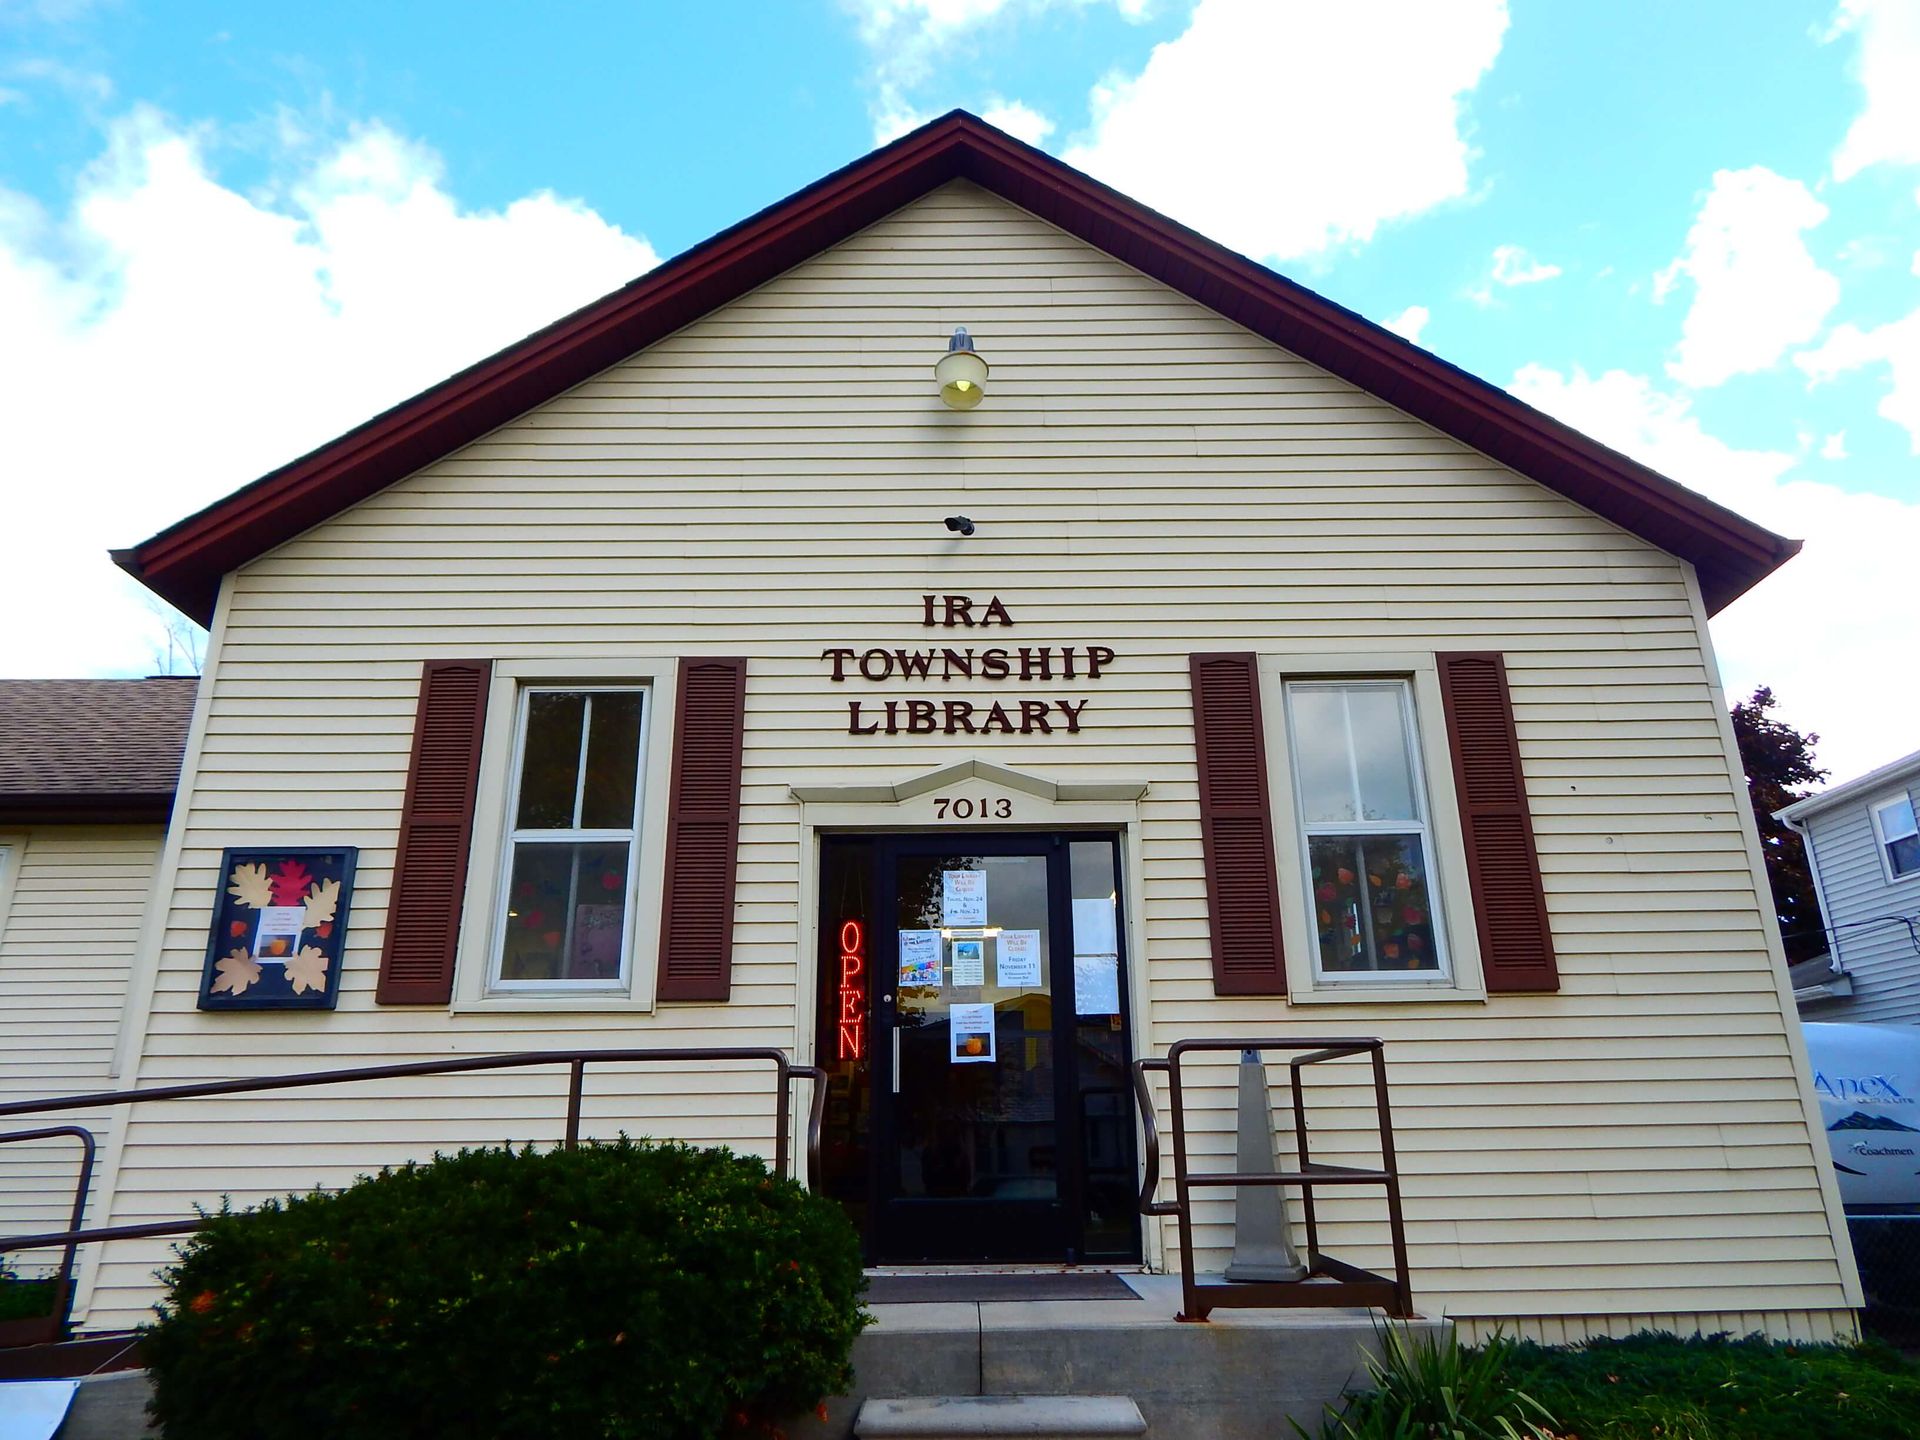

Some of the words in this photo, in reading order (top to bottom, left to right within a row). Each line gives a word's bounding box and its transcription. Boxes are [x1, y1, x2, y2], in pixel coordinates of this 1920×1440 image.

[923, 595, 1015, 627] IRA
[821, 646, 1115, 682] TOWNSHIP
[848, 699, 1089, 735] LIBRARY
[933, 798, 1012, 819] 7013
[840, 922, 861, 1059] OPEN
[1859, 1147, 1915, 1156] Coachmen
